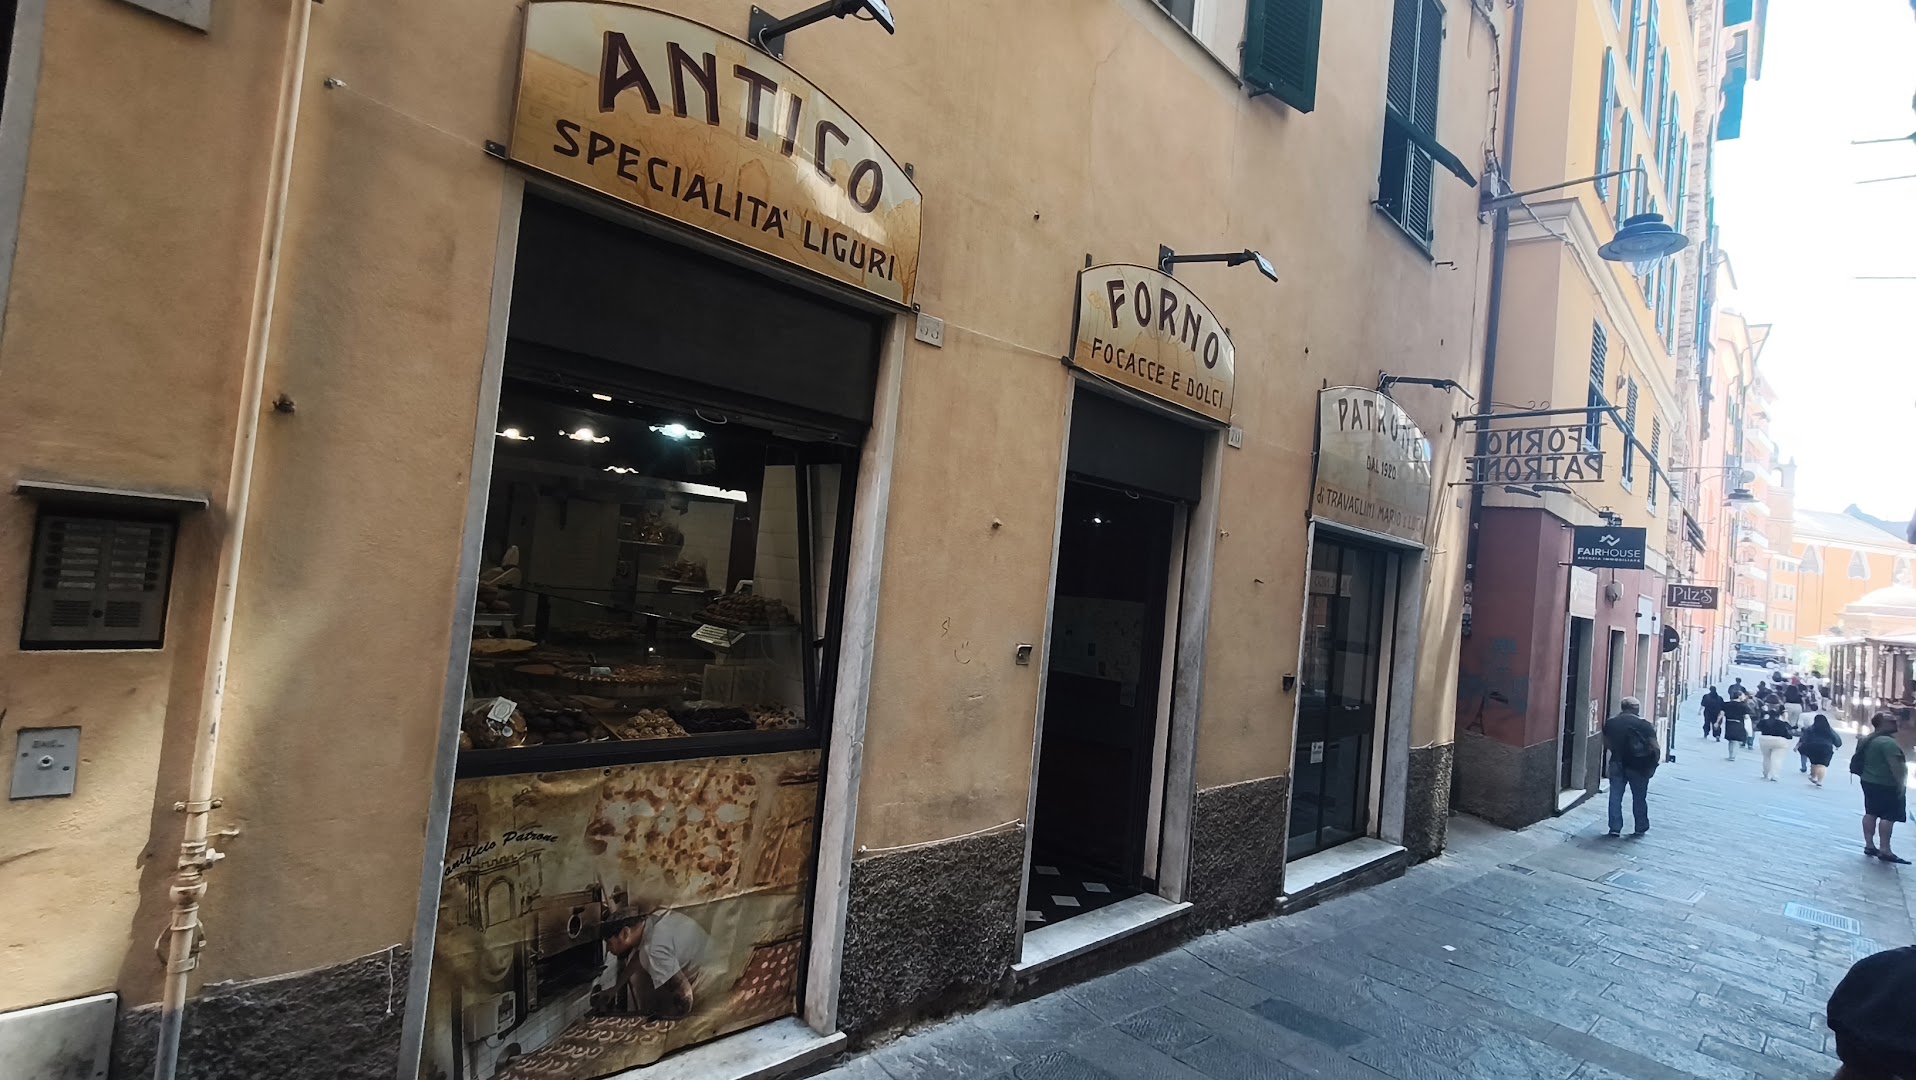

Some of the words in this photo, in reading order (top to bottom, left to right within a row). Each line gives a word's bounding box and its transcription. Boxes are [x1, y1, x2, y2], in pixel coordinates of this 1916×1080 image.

[599, 30, 884, 213] ANTICO
[803, 219, 895, 281] LIGURI
[1106, 279, 1219, 370] FORNO
[1091, 337, 1165, 385] FOCACCE
[1171, 371, 1180, 391] E
[1186, 377, 1224, 409] DOLCI
[1338, 398, 1423, 460] PATRONE
[1366, 454, 1380, 474] DAL
[1381, 461, 1397, 480] 1920
[1577, 547, 1640, 558] FAIRHOUSE
[444, 841, 496, 876] anificio
[502, 831, 559, 846] Patrone
